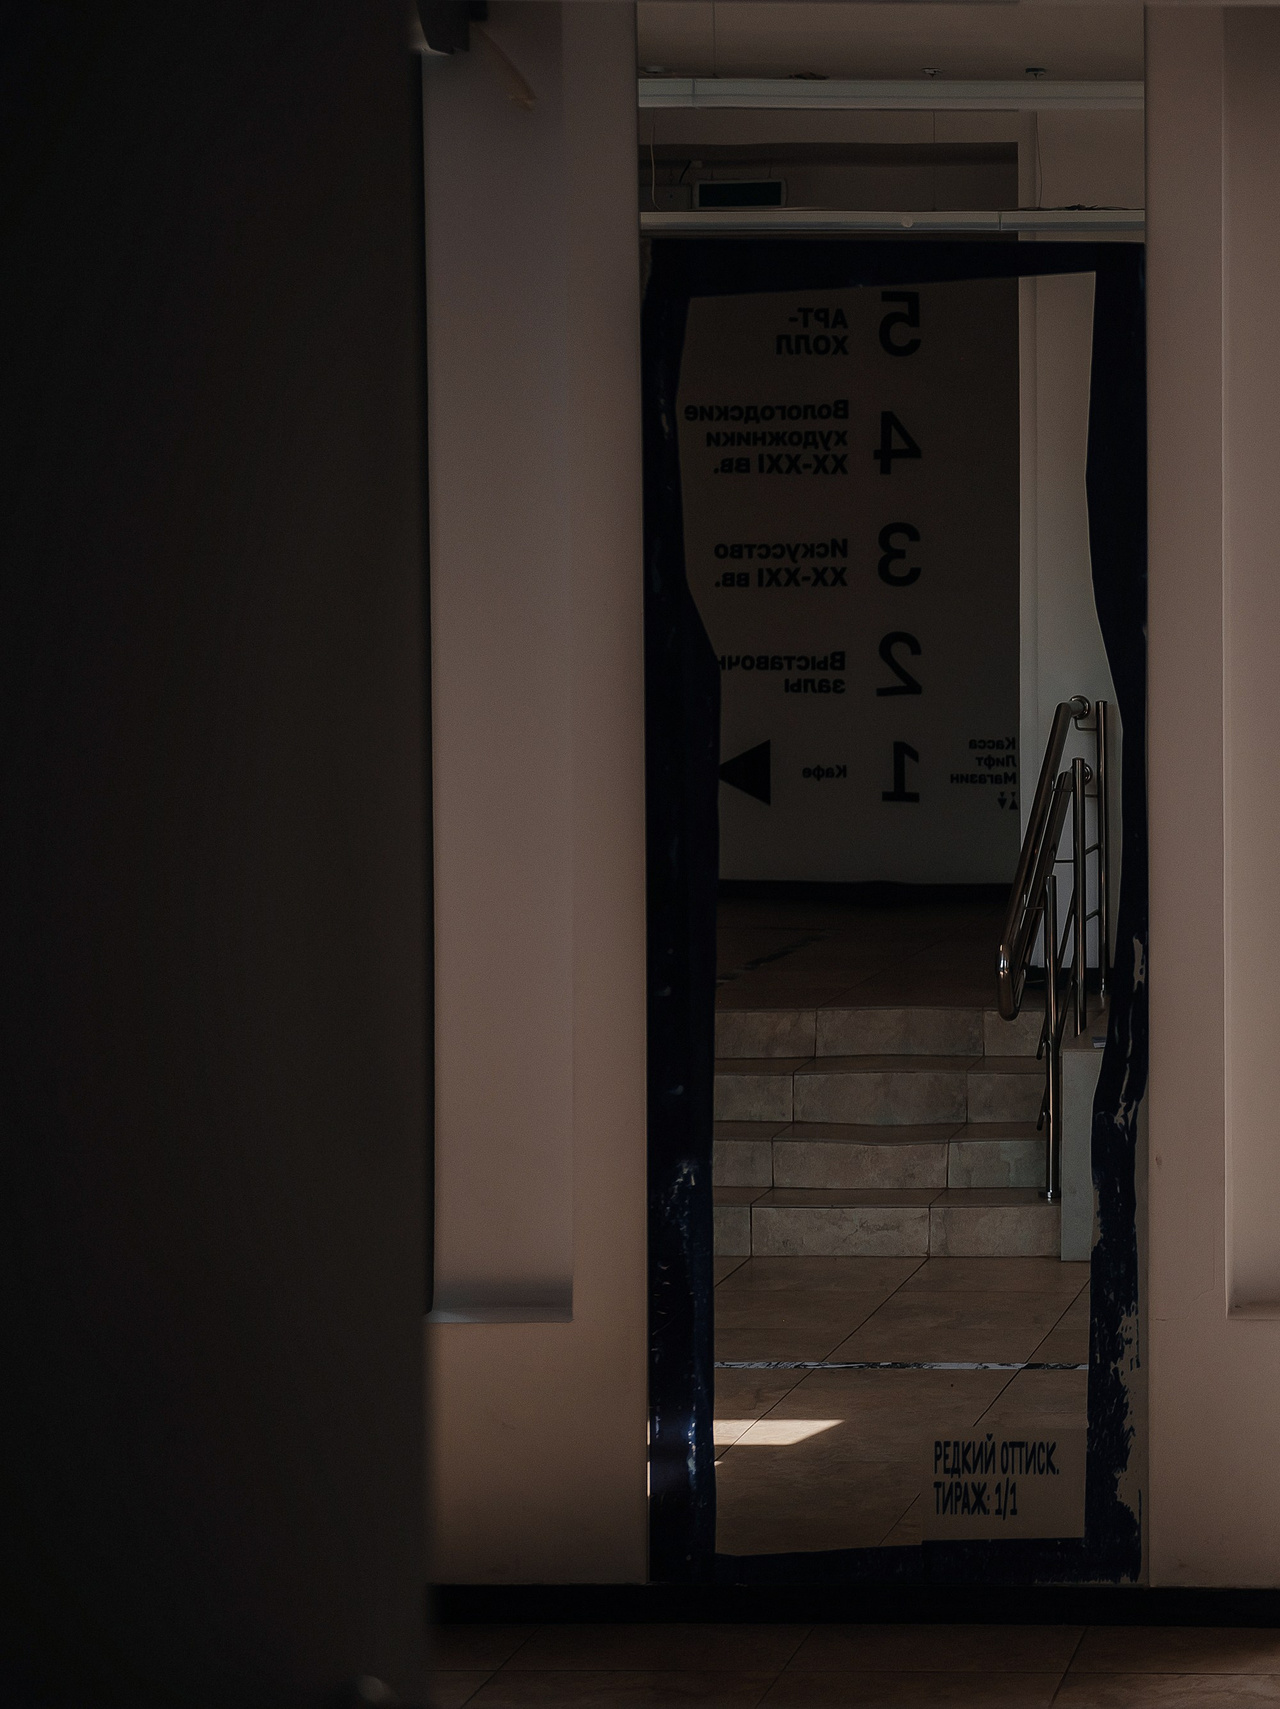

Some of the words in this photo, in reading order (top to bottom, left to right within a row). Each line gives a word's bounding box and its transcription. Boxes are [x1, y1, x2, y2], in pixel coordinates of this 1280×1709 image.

[934, 1433, 996, 1478] РЕДКИЙ
[934, 1481, 990, 1515] ТИРАЖ:
[995, 1477, 1018, 1520] 1/1
